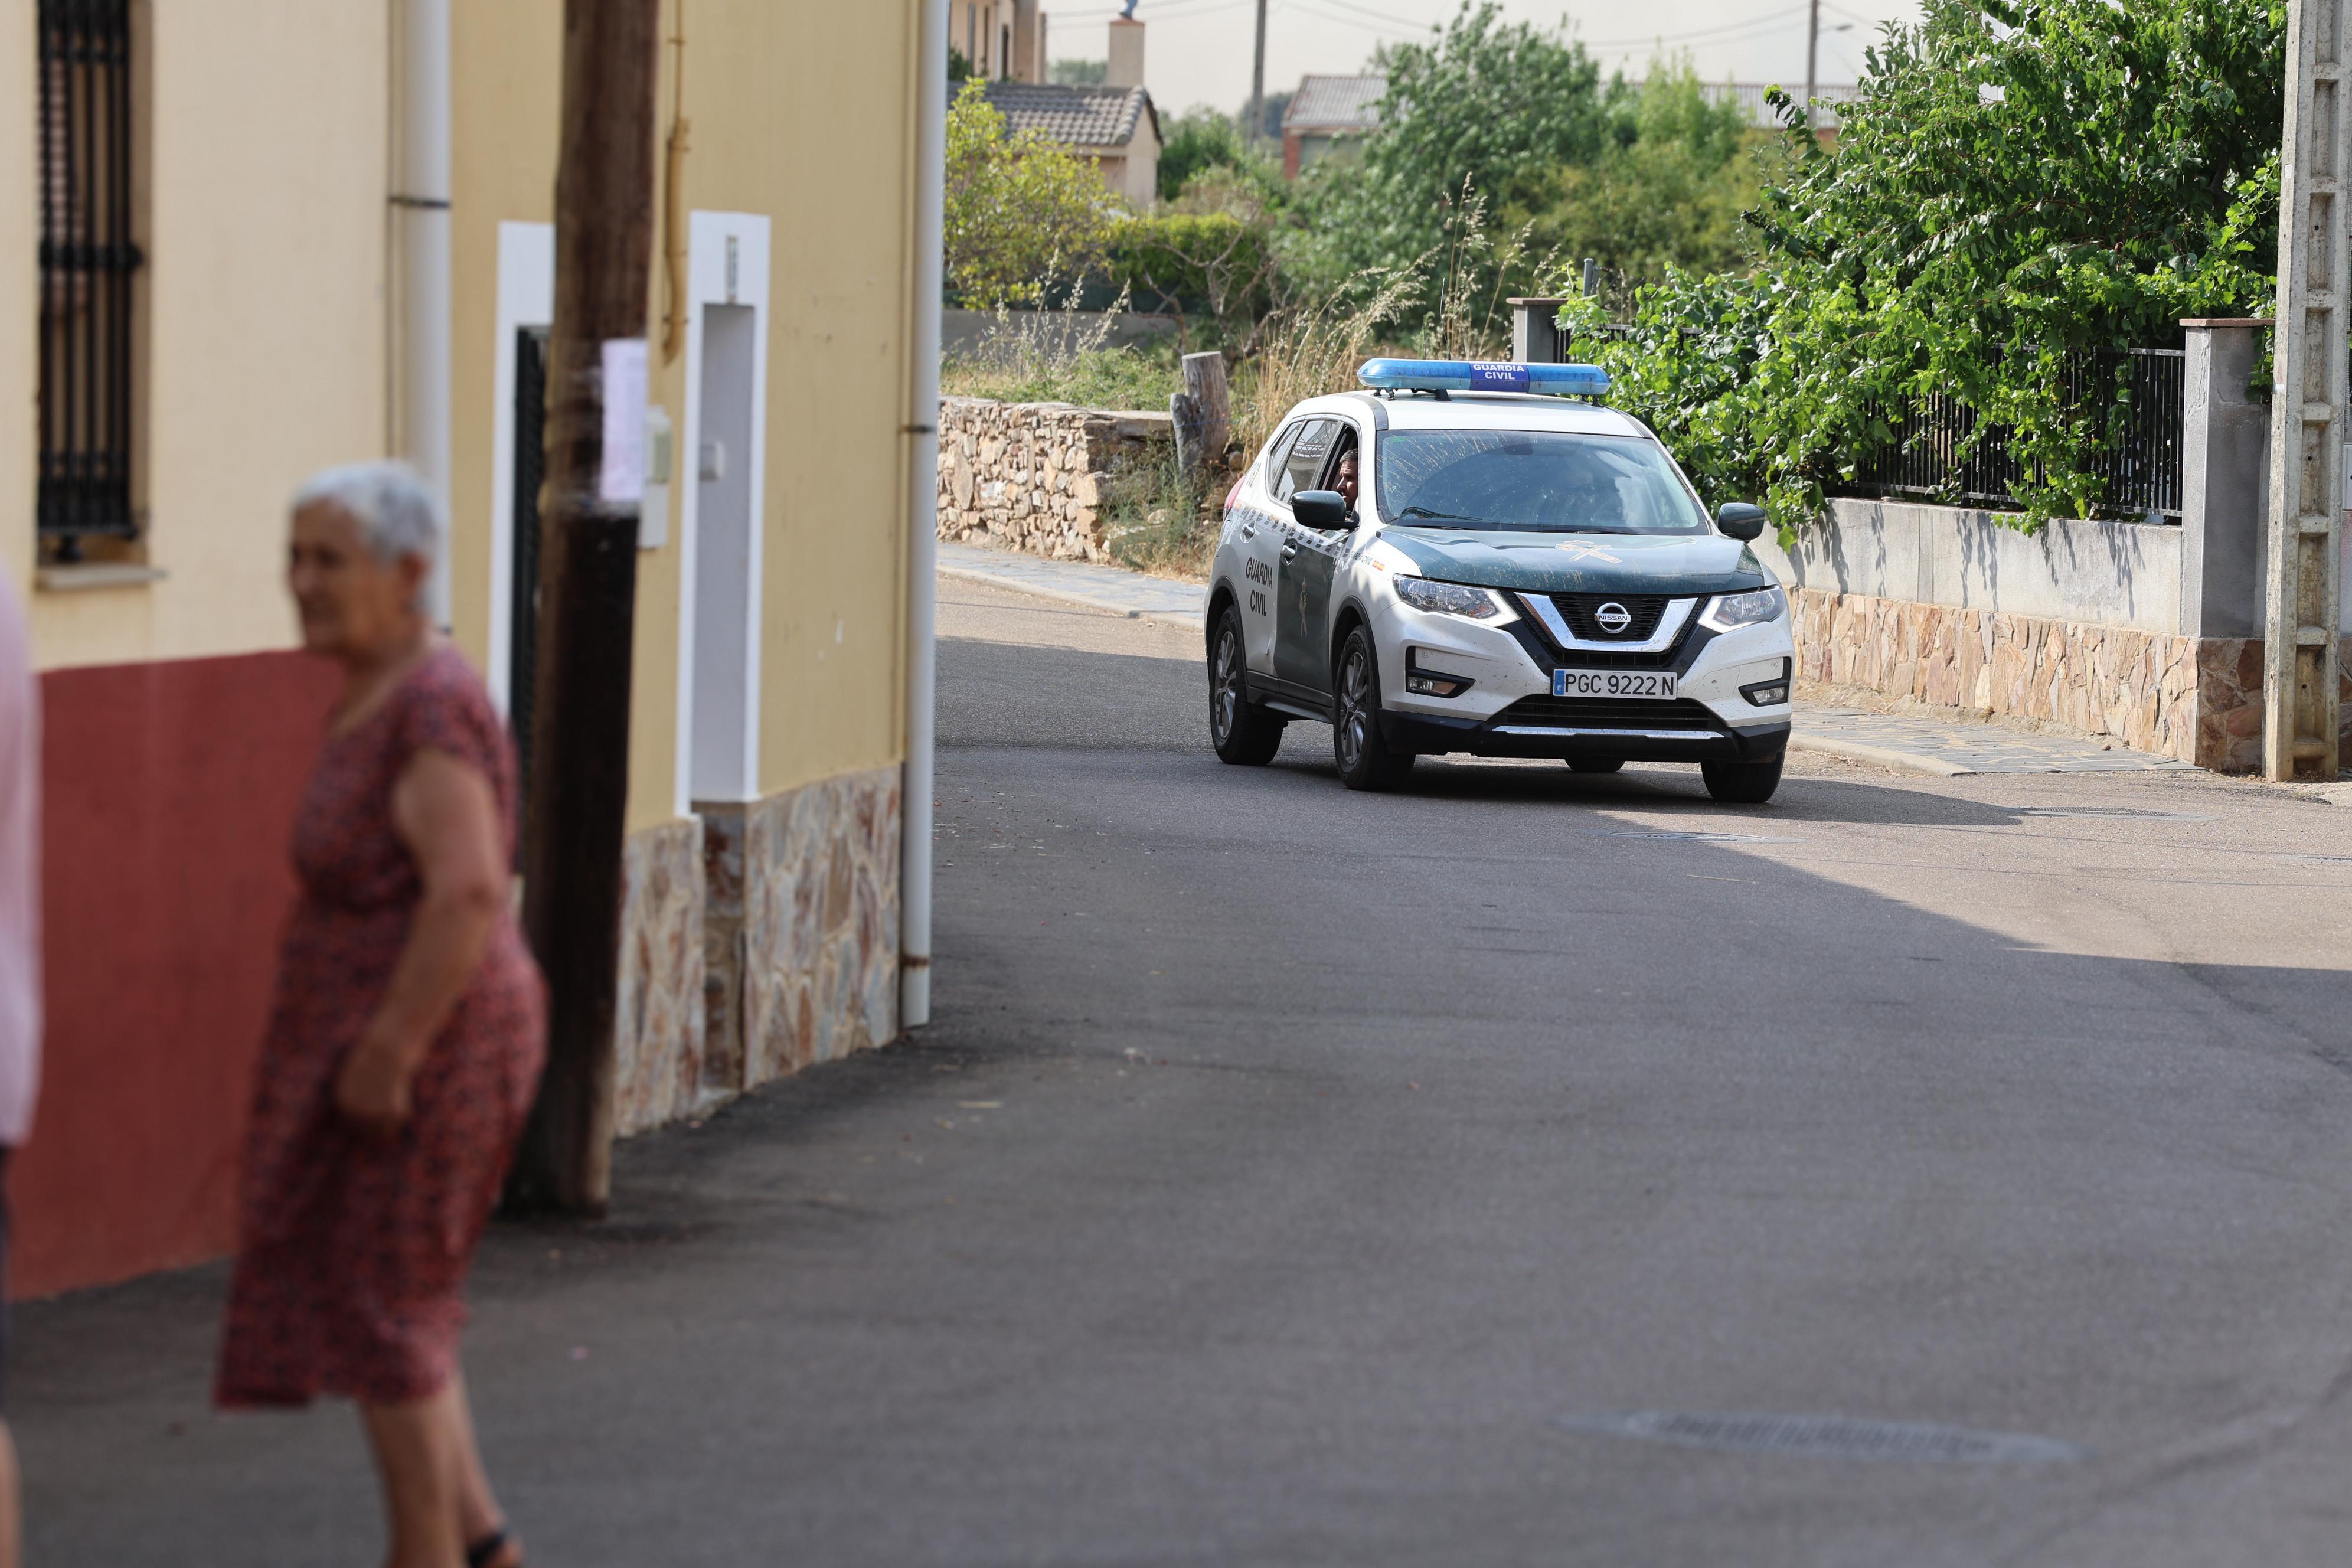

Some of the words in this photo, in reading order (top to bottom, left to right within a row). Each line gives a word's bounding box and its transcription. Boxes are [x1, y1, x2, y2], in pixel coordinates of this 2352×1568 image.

[1485, 371, 1515, 380] CIVIL
[1246, 557, 1273, 589] GUARDIA
[1250, 589, 1267, 617] CIVIL
[1565, 674, 1602, 694] PGC
[1608, 675, 1657, 695] 9222
[1662, 677, 1674, 696] N
